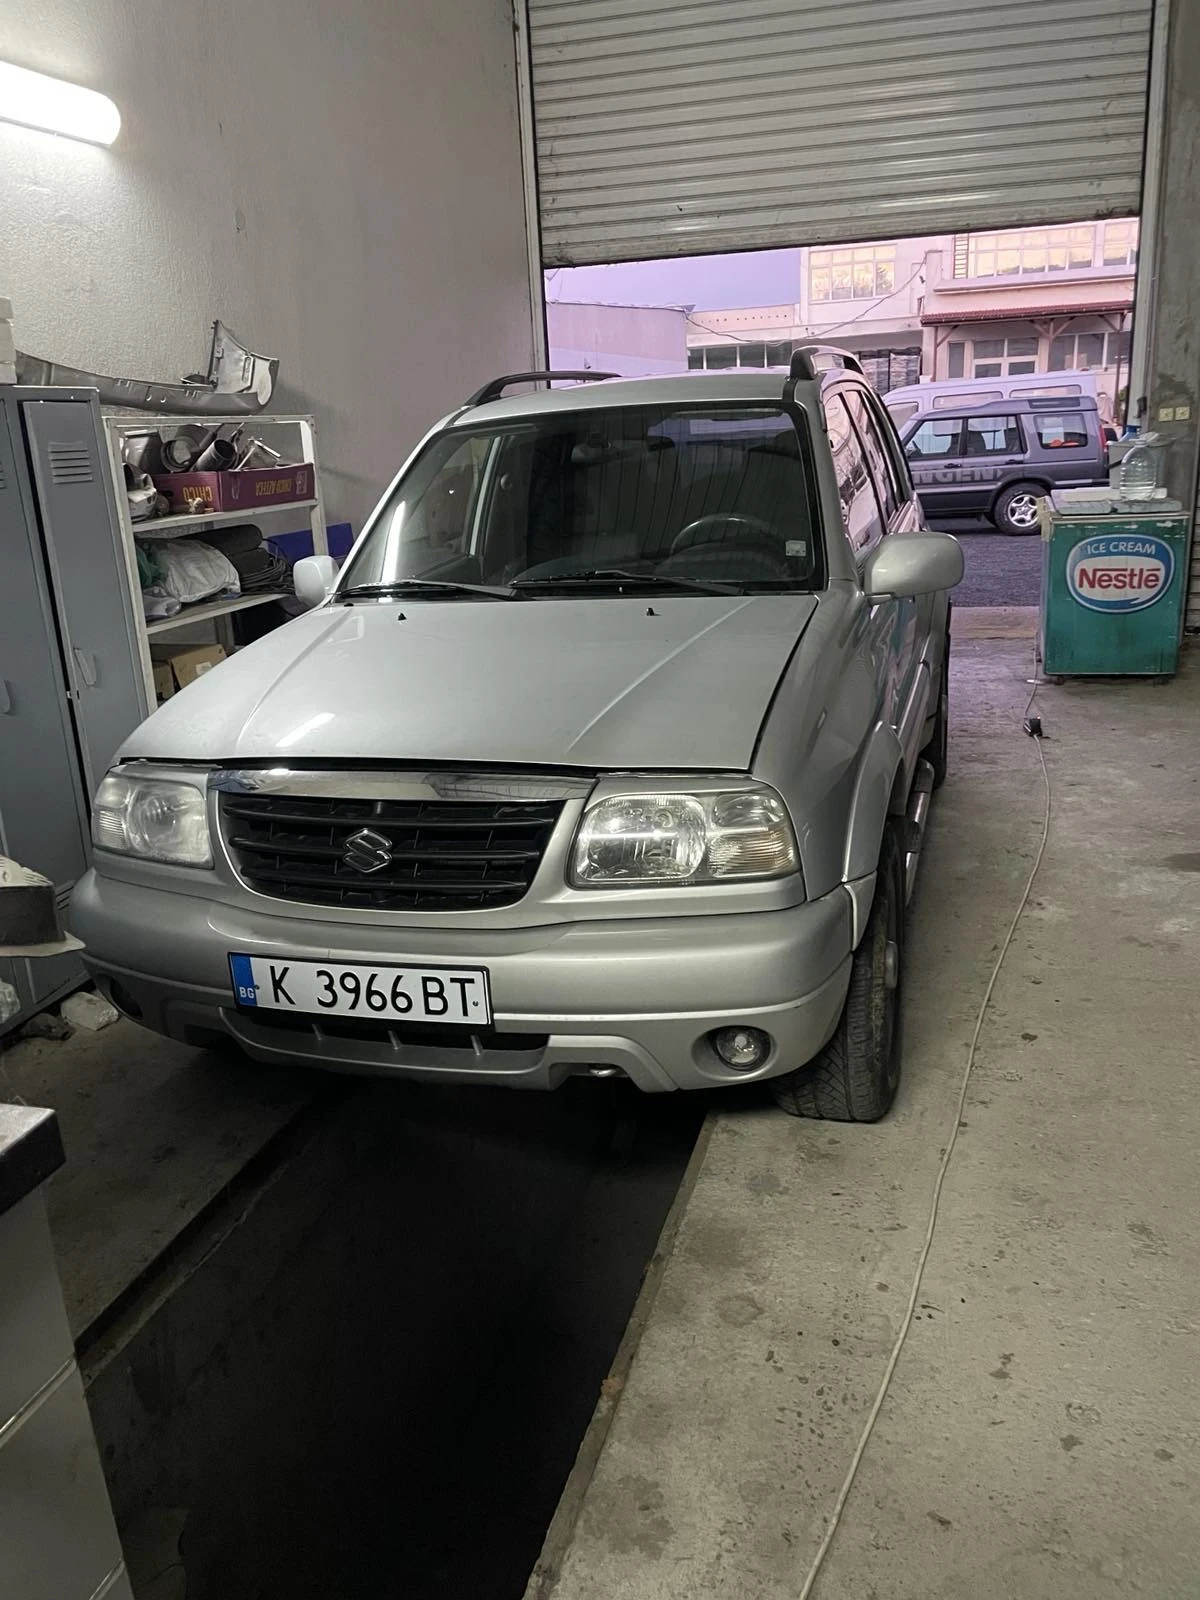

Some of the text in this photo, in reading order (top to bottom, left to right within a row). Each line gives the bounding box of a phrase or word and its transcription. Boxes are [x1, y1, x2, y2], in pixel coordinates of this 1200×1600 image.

[182, 486, 213, 502] CHICO
[1087, 541, 1156, 555] ICE CREAM
[269, 965, 296, 1005] K
[239, 987, 255, 999] BG
